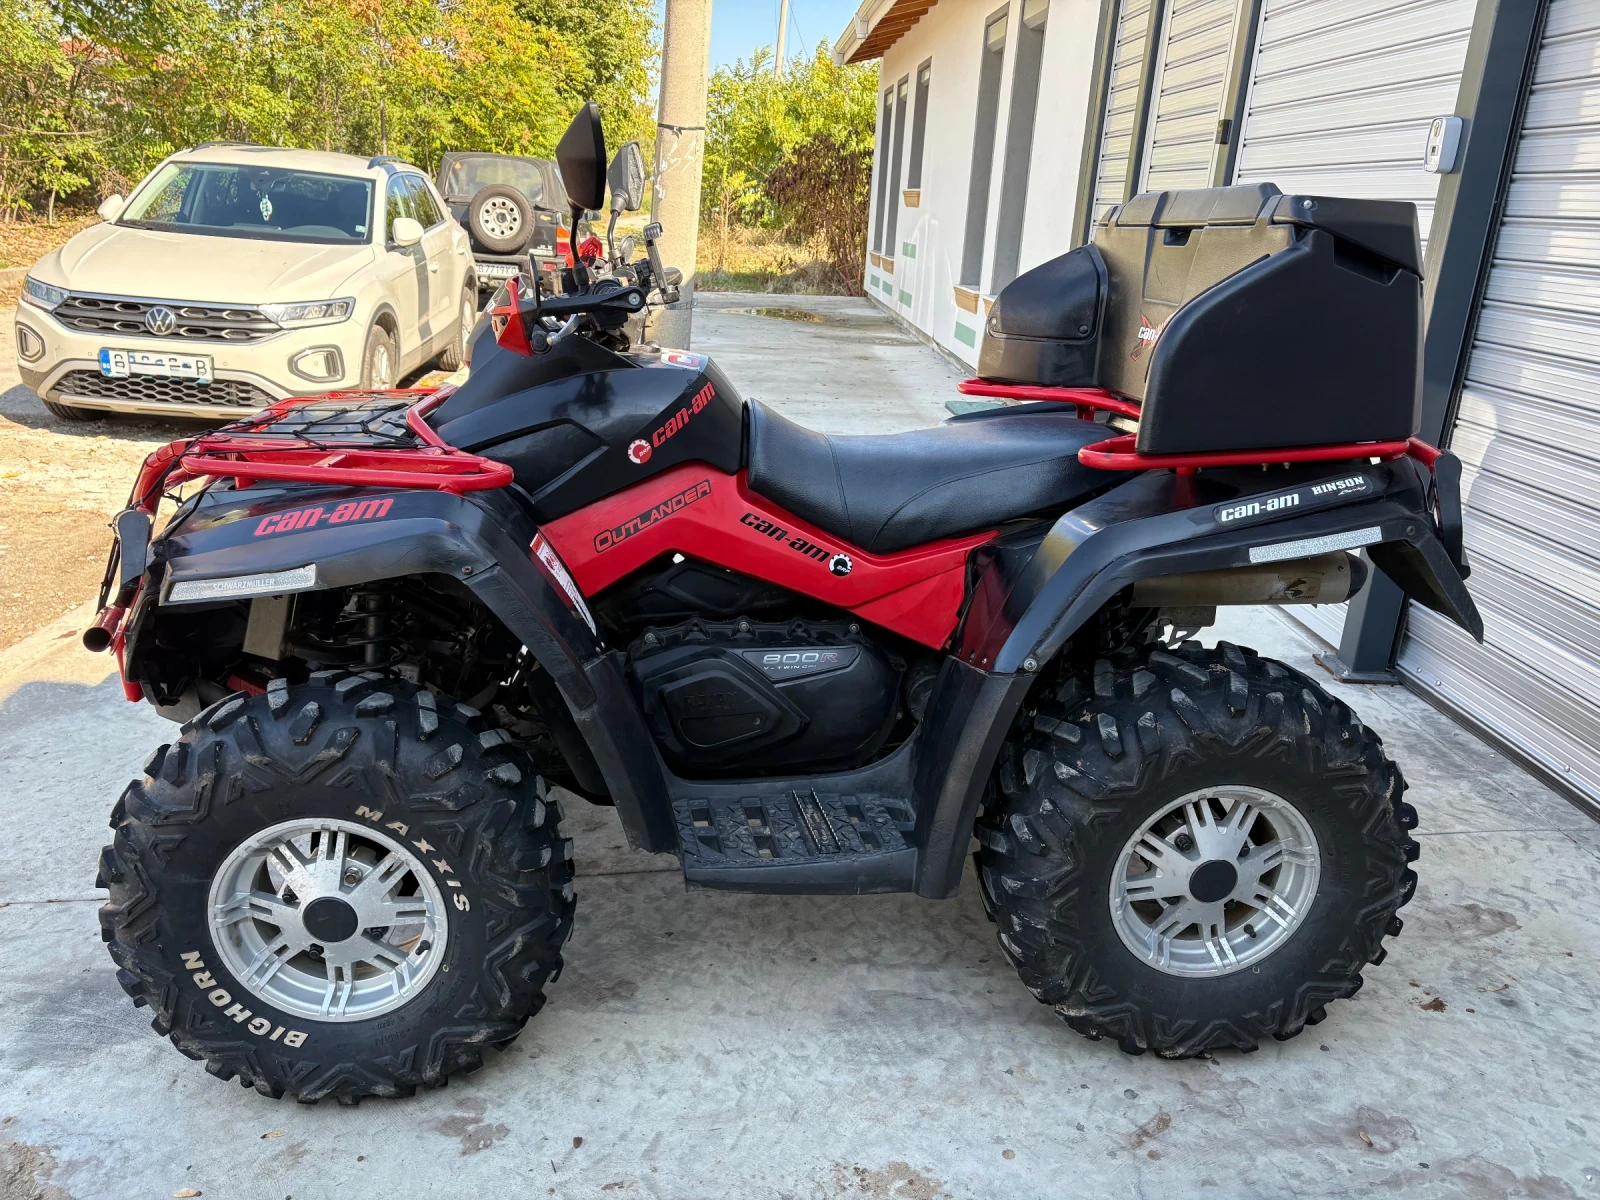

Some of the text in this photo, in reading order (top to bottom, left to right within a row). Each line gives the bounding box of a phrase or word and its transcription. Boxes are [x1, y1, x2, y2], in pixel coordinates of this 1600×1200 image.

[652, 381, 716, 448] can-am
[1221, 493, 1300, 522] can-am
[1311, 476, 1364, 495] HINSON
[253, 498, 395, 537] can-am
[594, 480, 711, 553] OUTLANDER
[740, 512, 831, 562] can-am
[763, 652, 838, 665] 800R
[355, 805, 470, 912] MAXXIS
[180, 950, 309, 1048] BIGHORN
